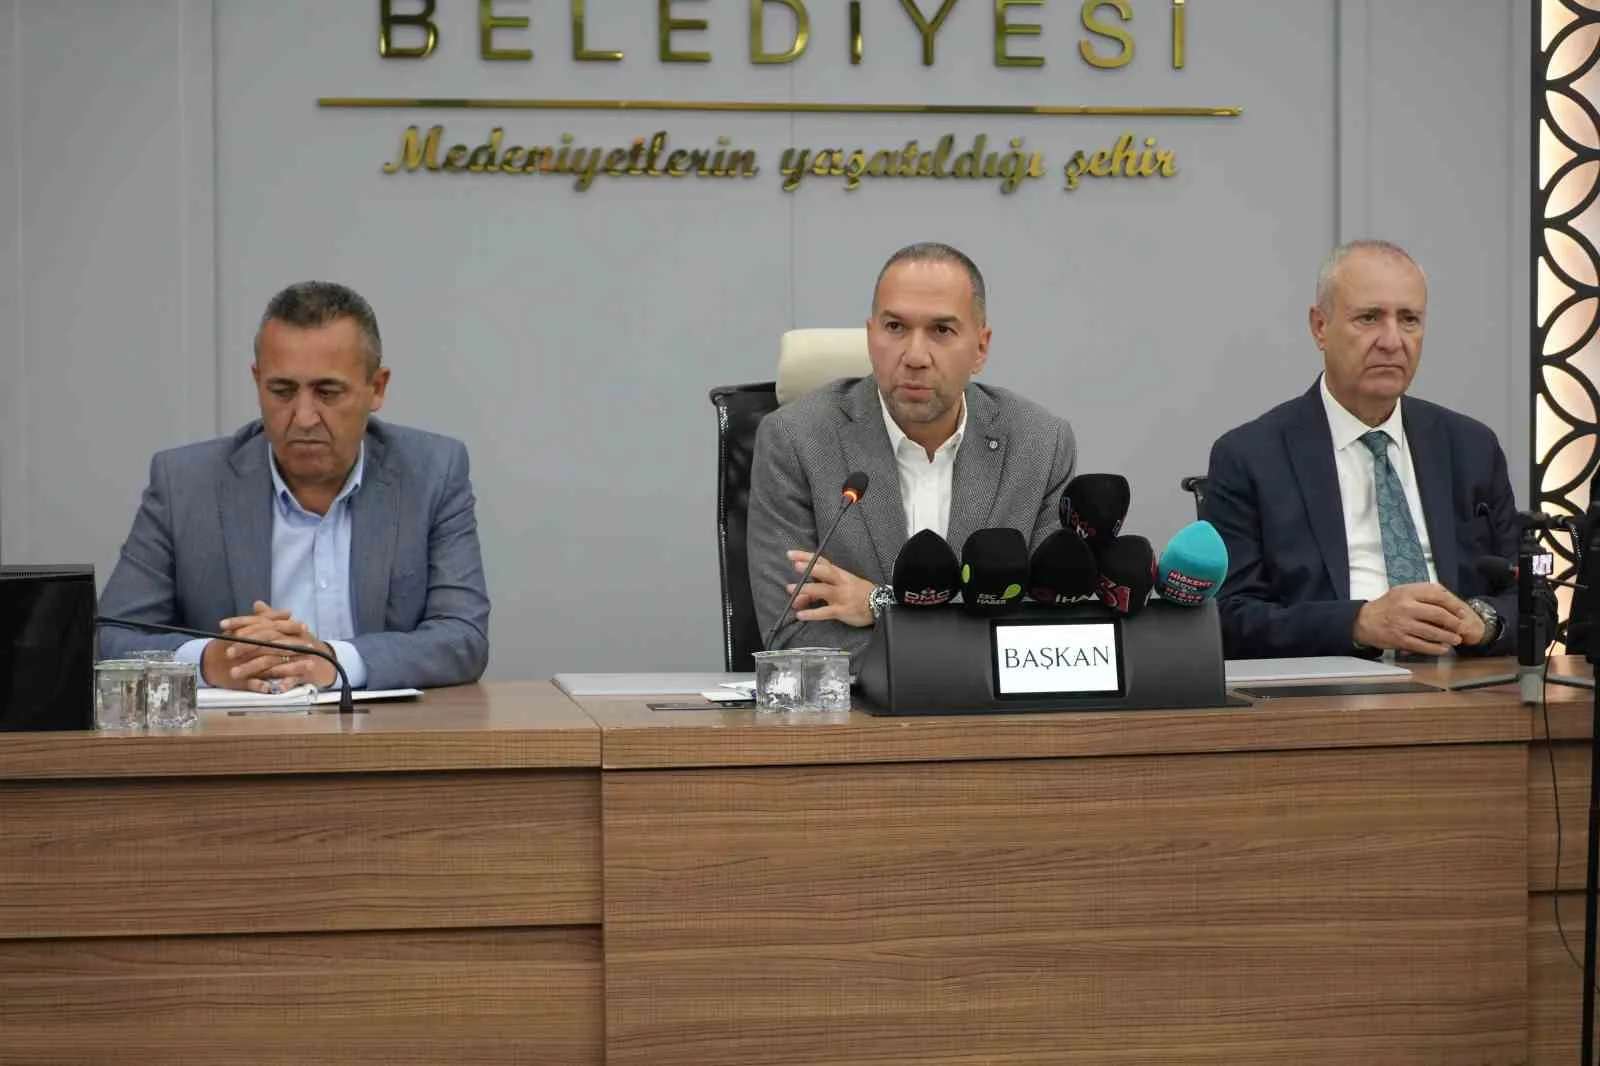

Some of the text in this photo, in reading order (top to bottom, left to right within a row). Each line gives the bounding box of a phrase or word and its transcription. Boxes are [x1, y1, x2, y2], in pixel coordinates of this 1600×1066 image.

[383, 124, 760, 193] Medeniyetlerin
[1063, 133, 1180, 192] şehir
[1004, 645, 1110, 670] BAŞKAN
